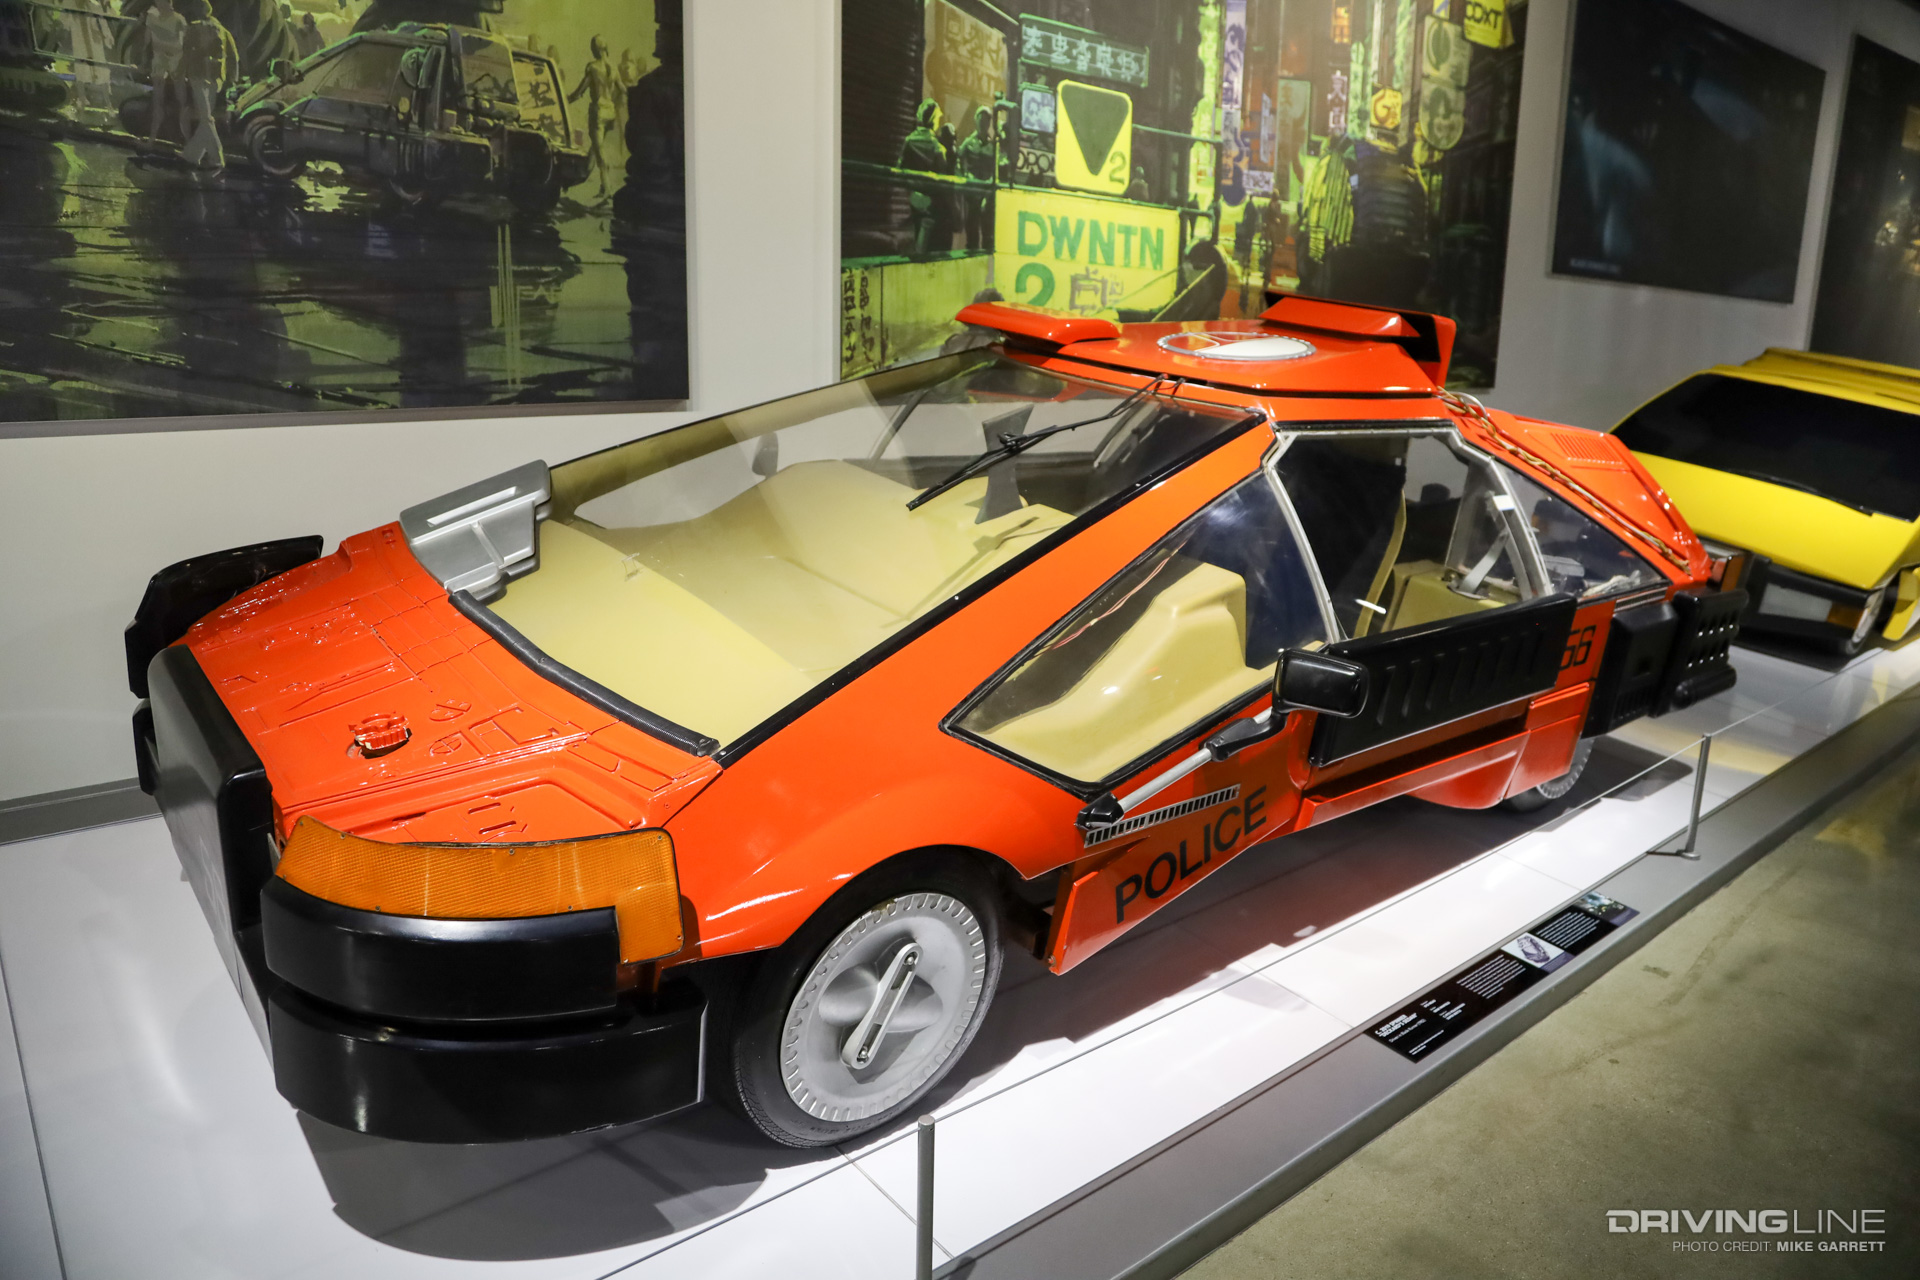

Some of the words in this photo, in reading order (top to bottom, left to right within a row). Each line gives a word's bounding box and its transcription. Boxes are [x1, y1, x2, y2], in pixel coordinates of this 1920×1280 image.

[1109, 151, 1127, 185] 2
[1017, 210, 1165, 271] DWNTN
[1015, 262, 1055, 307] 2
[1115, 785, 1267, 925] POLICE
